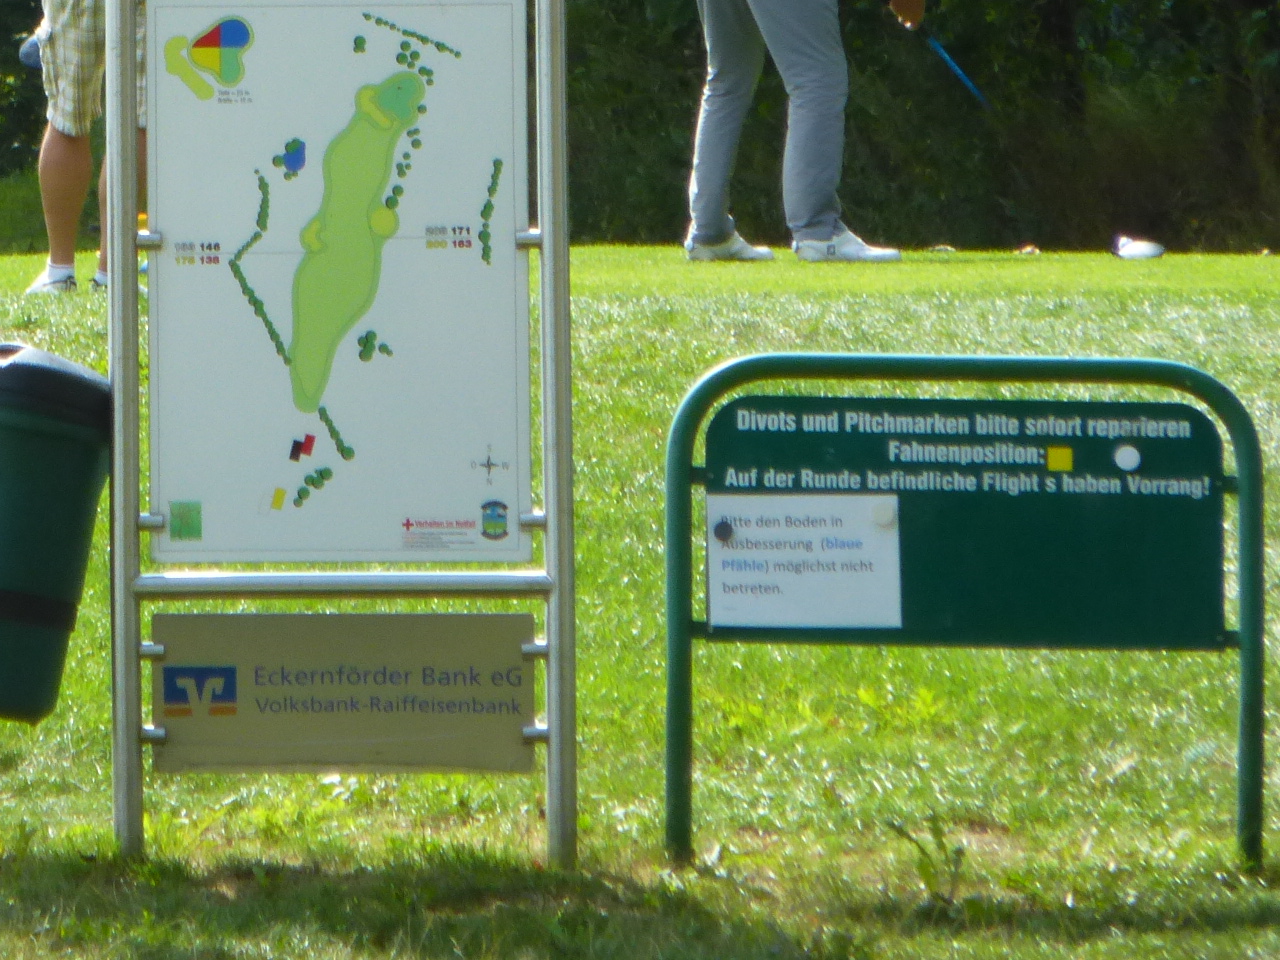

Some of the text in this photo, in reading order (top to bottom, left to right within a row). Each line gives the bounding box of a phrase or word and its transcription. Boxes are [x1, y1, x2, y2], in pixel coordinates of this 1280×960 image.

[451, 226, 471, 236] 171
[736, 410, 1192, 440] Divots und Pitchmarken bitte sofort reparieren
[888, 440, 1045, 466] Fahnenposition:
[725, 467, 758, 488] Auf
[764, 468, 795, 489] der
[801, 468, 862, 490] Runde
[867, 469, 977, 492] befindliche
[1062, 473, 1122, 495] haben
[1127, 475, 1210, 500] Vorrang!
[756, 515, 781, 528] den
[785, 515, 827, 529] Boden
[831, 515, 844, 528] in
[773, 559, 837, 576] möglichst
[841, 559, 875, 573] nicht
[254, 665, 522, 688] Eckernförder Bank eG
[255, 695, 521, 715] Volksbank-Raiffeisenbank
